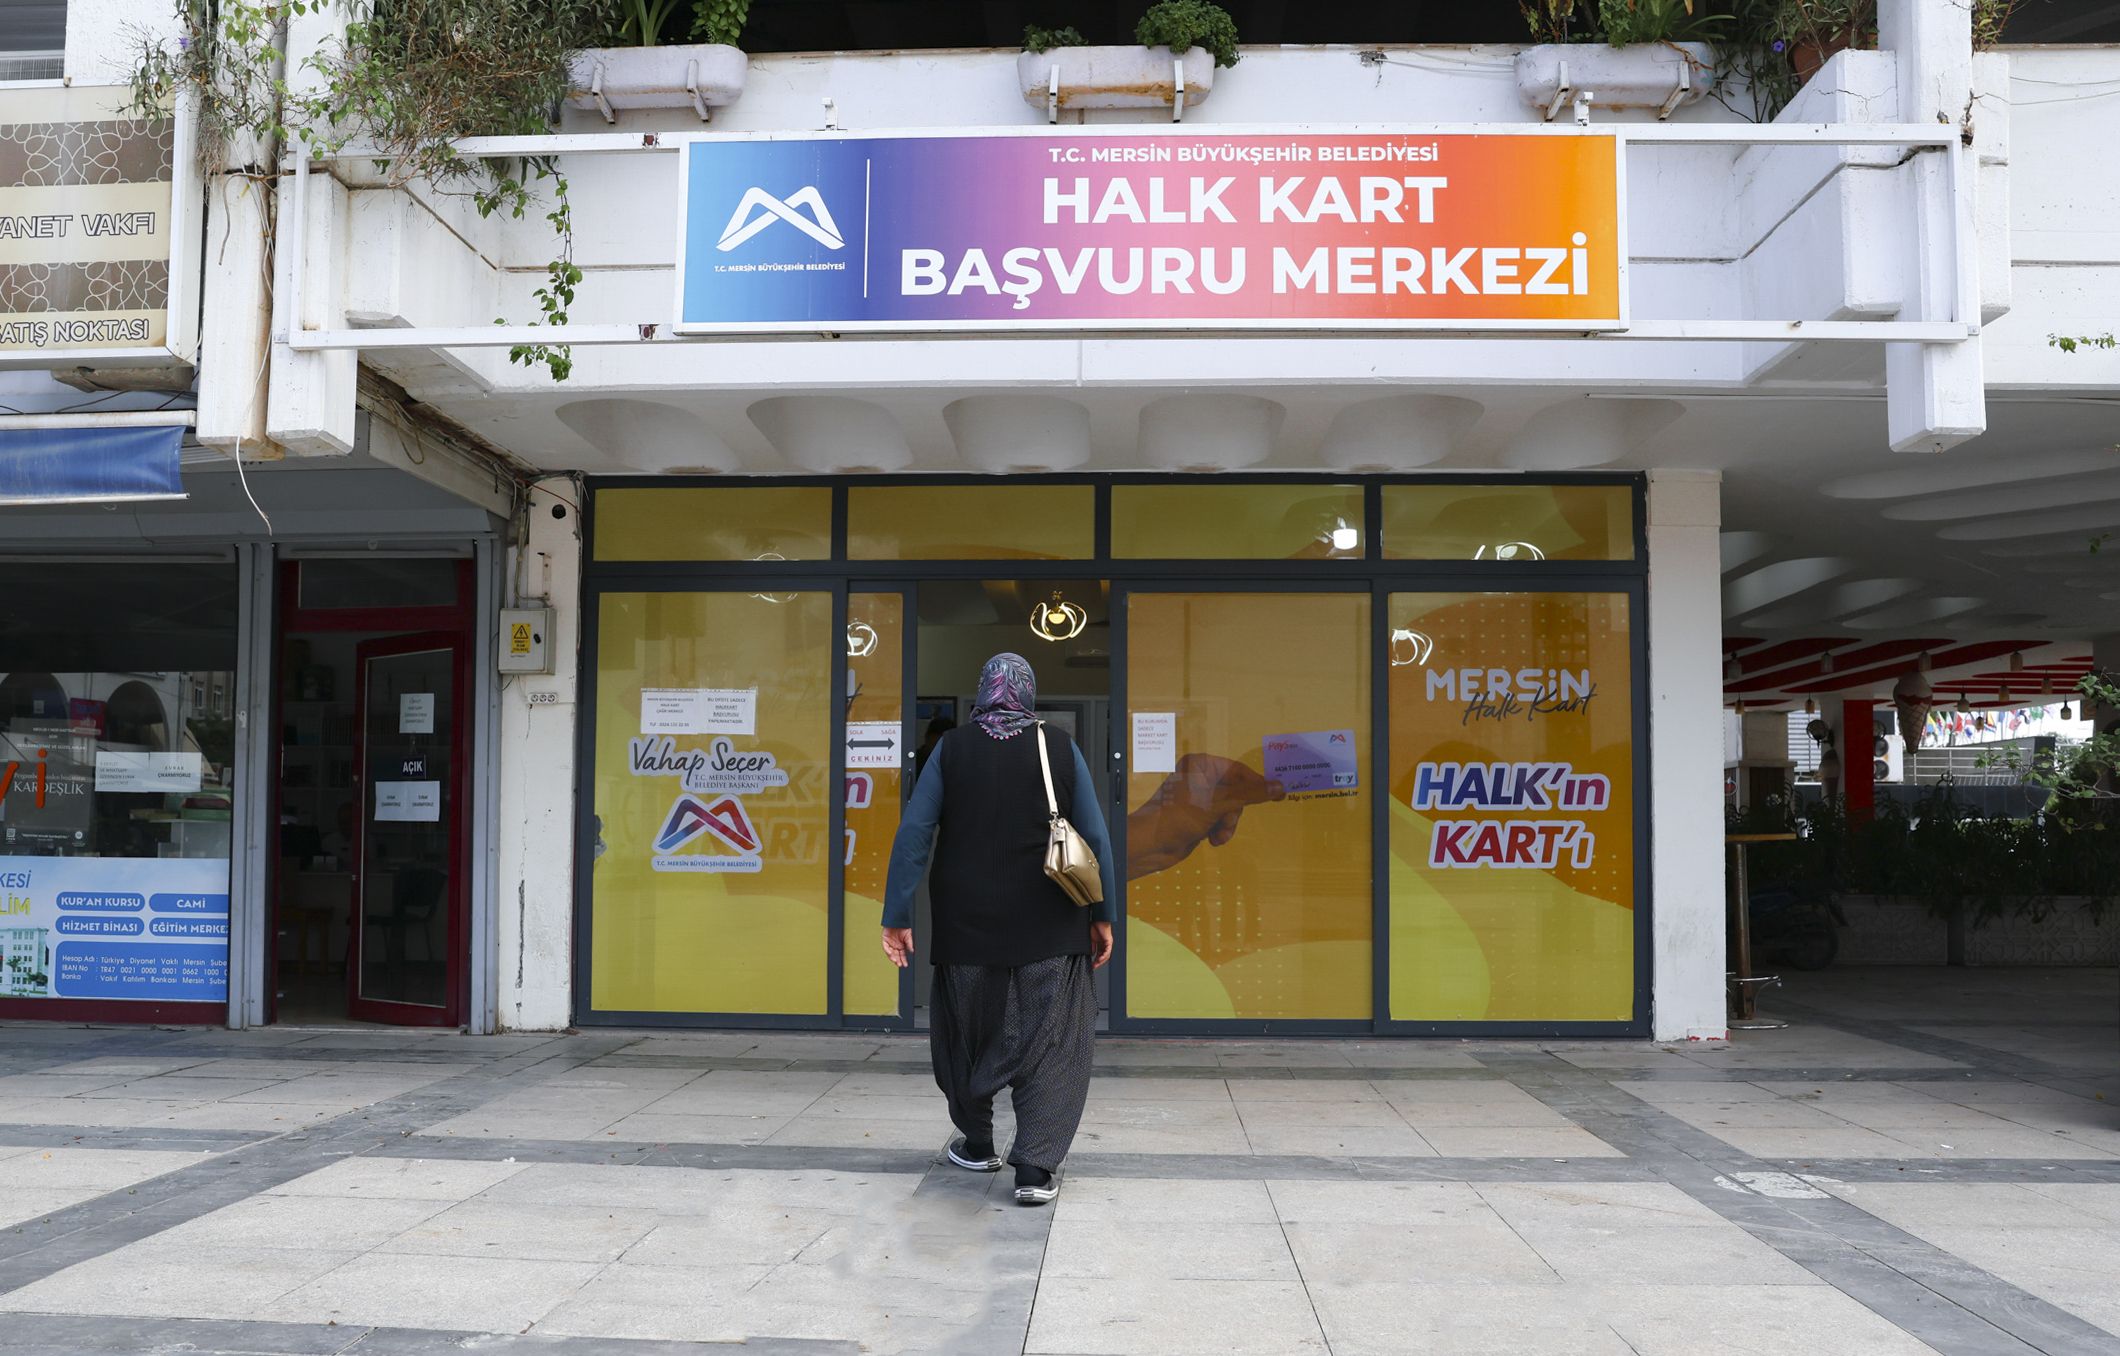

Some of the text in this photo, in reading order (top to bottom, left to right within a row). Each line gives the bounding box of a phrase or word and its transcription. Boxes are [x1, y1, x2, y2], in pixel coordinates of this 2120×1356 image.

[1048, 142, 1439, 165] T.C. MERSİN BÜYÜKŞEHİR BELEDİYESİ
[1042, 176, 1448, 225] HALK KART
[0, 212, 156, 239] ANET VAKFI
[714, 261, 846, 273] T.C. MERSİN BÜYÜKŞEHİR BELEDİYESİ
[900, 231, 1589, 311] BAŞVURU MERKEZİ
[0, 319, 149, 347] ATIŞ NOKTASI
[1462, 682, 1598, 727] Halk Kart
[633, 738, 771, 787] Vahap Seçer
[850, 754, 894, 763] ÇEKİNİZ
[402, 760, 424, 775] AÇIK
[695, 773, 784, 783] T.C. MERSİN BÜYÜKŞEHİR
[729, 782, 759, 790] BAŞKANI
[1416, 767, 1606, 806] HALK'ın
[1434, 826, 1590, 863] KART'ı
[690, 860, 726, 869] BÜYÜKŞEHİR
[61, 897, 141, 907] KUR'AN KURSU
[176, 897, 206, 909] CAMİ
[62, 919, 138, 932] HİZMET BİNASI
[152, 921, 187, 934] EĞİTİM
[62, 955, 83, 964] Hesap
[101, 956, 125, 966] Türkiye
[130, 957, 156, 967] Diyanet
[204, 968, 220, 976] 1000
